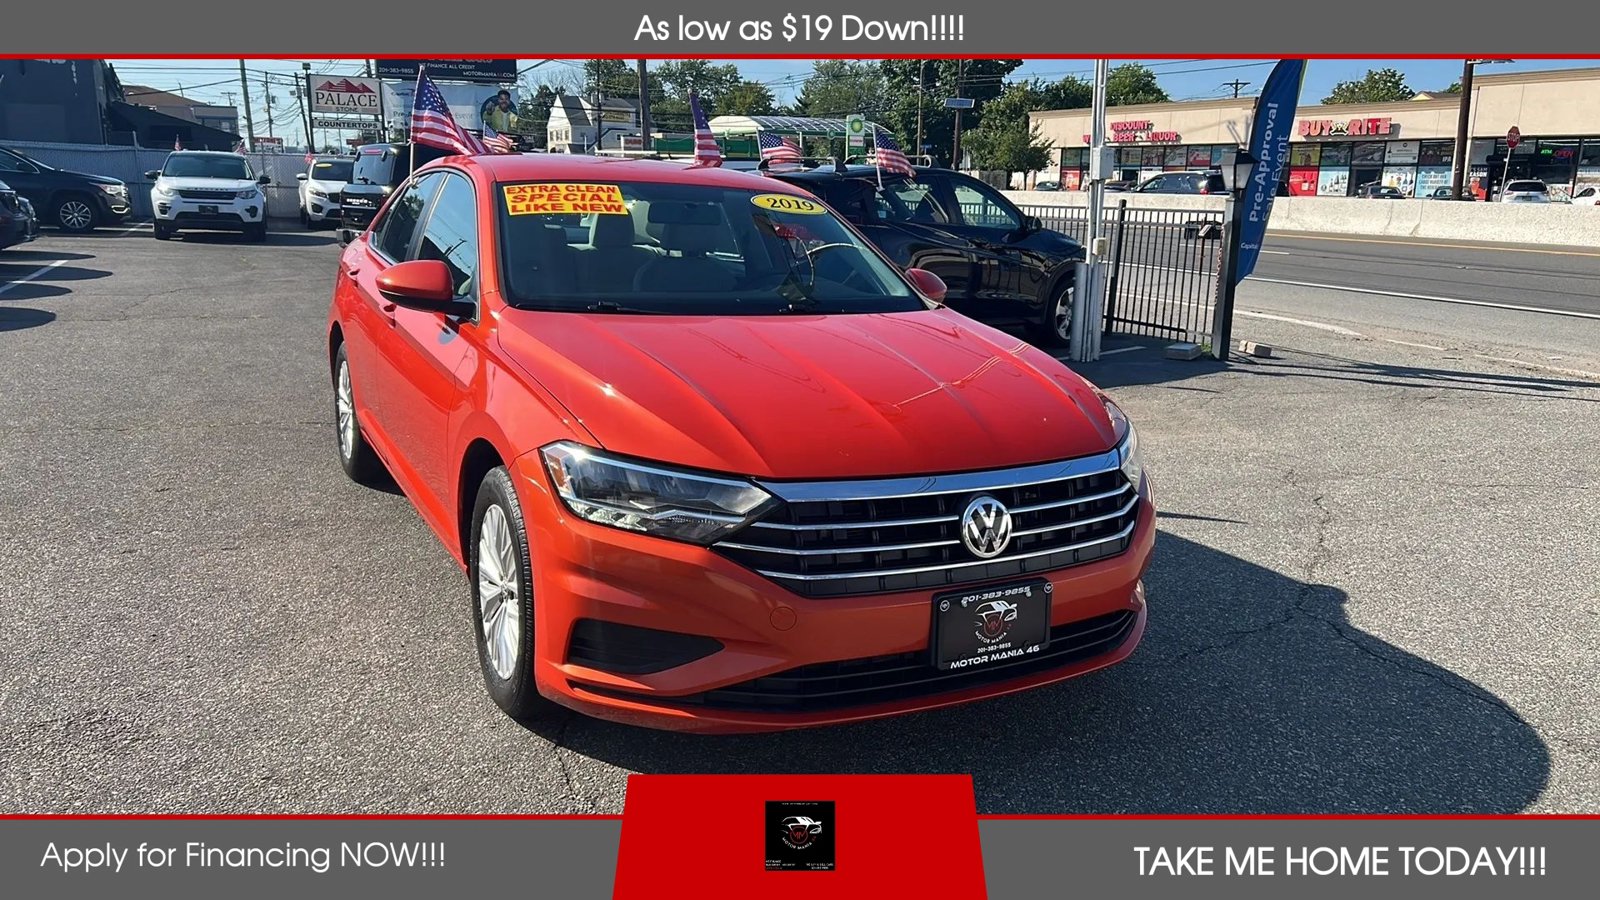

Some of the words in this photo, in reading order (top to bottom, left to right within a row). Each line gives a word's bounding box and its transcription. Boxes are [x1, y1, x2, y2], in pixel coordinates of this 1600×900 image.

[315, 91, 378, 107] PALACE
[318, 121, 378, 129] COUNTERTOPS
[1110, 120, 1151, 131] DISCOUNT
[1298, 119, 1333, 136] BUY
[1348, 117, 1392, 136] RITE
[1113, 132, 1135, 142] BEER
[1145, 131, 1178, 141] LIQUOR
[1249, 102, 1278, 222] Pre-Approval
[1272, 134, 1289, 182] Event
[506, 185, 560, 194] EXTRA
[565, 185, 616, 193] CLEAN
[511, 193, 618, 203] SPECIAL
[766, 197, 815, 211] 2019
[511, 203, 566, 213] LIKE
[572, 203, 622, 213] NEW
[961, 586, 1031, 604] 201-383-9855
[975, 630, 990, 644] MOTOR
[991, 631, 1007, 644] MANIA
[950, 655, 989, 669] MOTOR
[990, 648, 1025, 662] MANIA
[1026, 644, 1040, 654] 46
